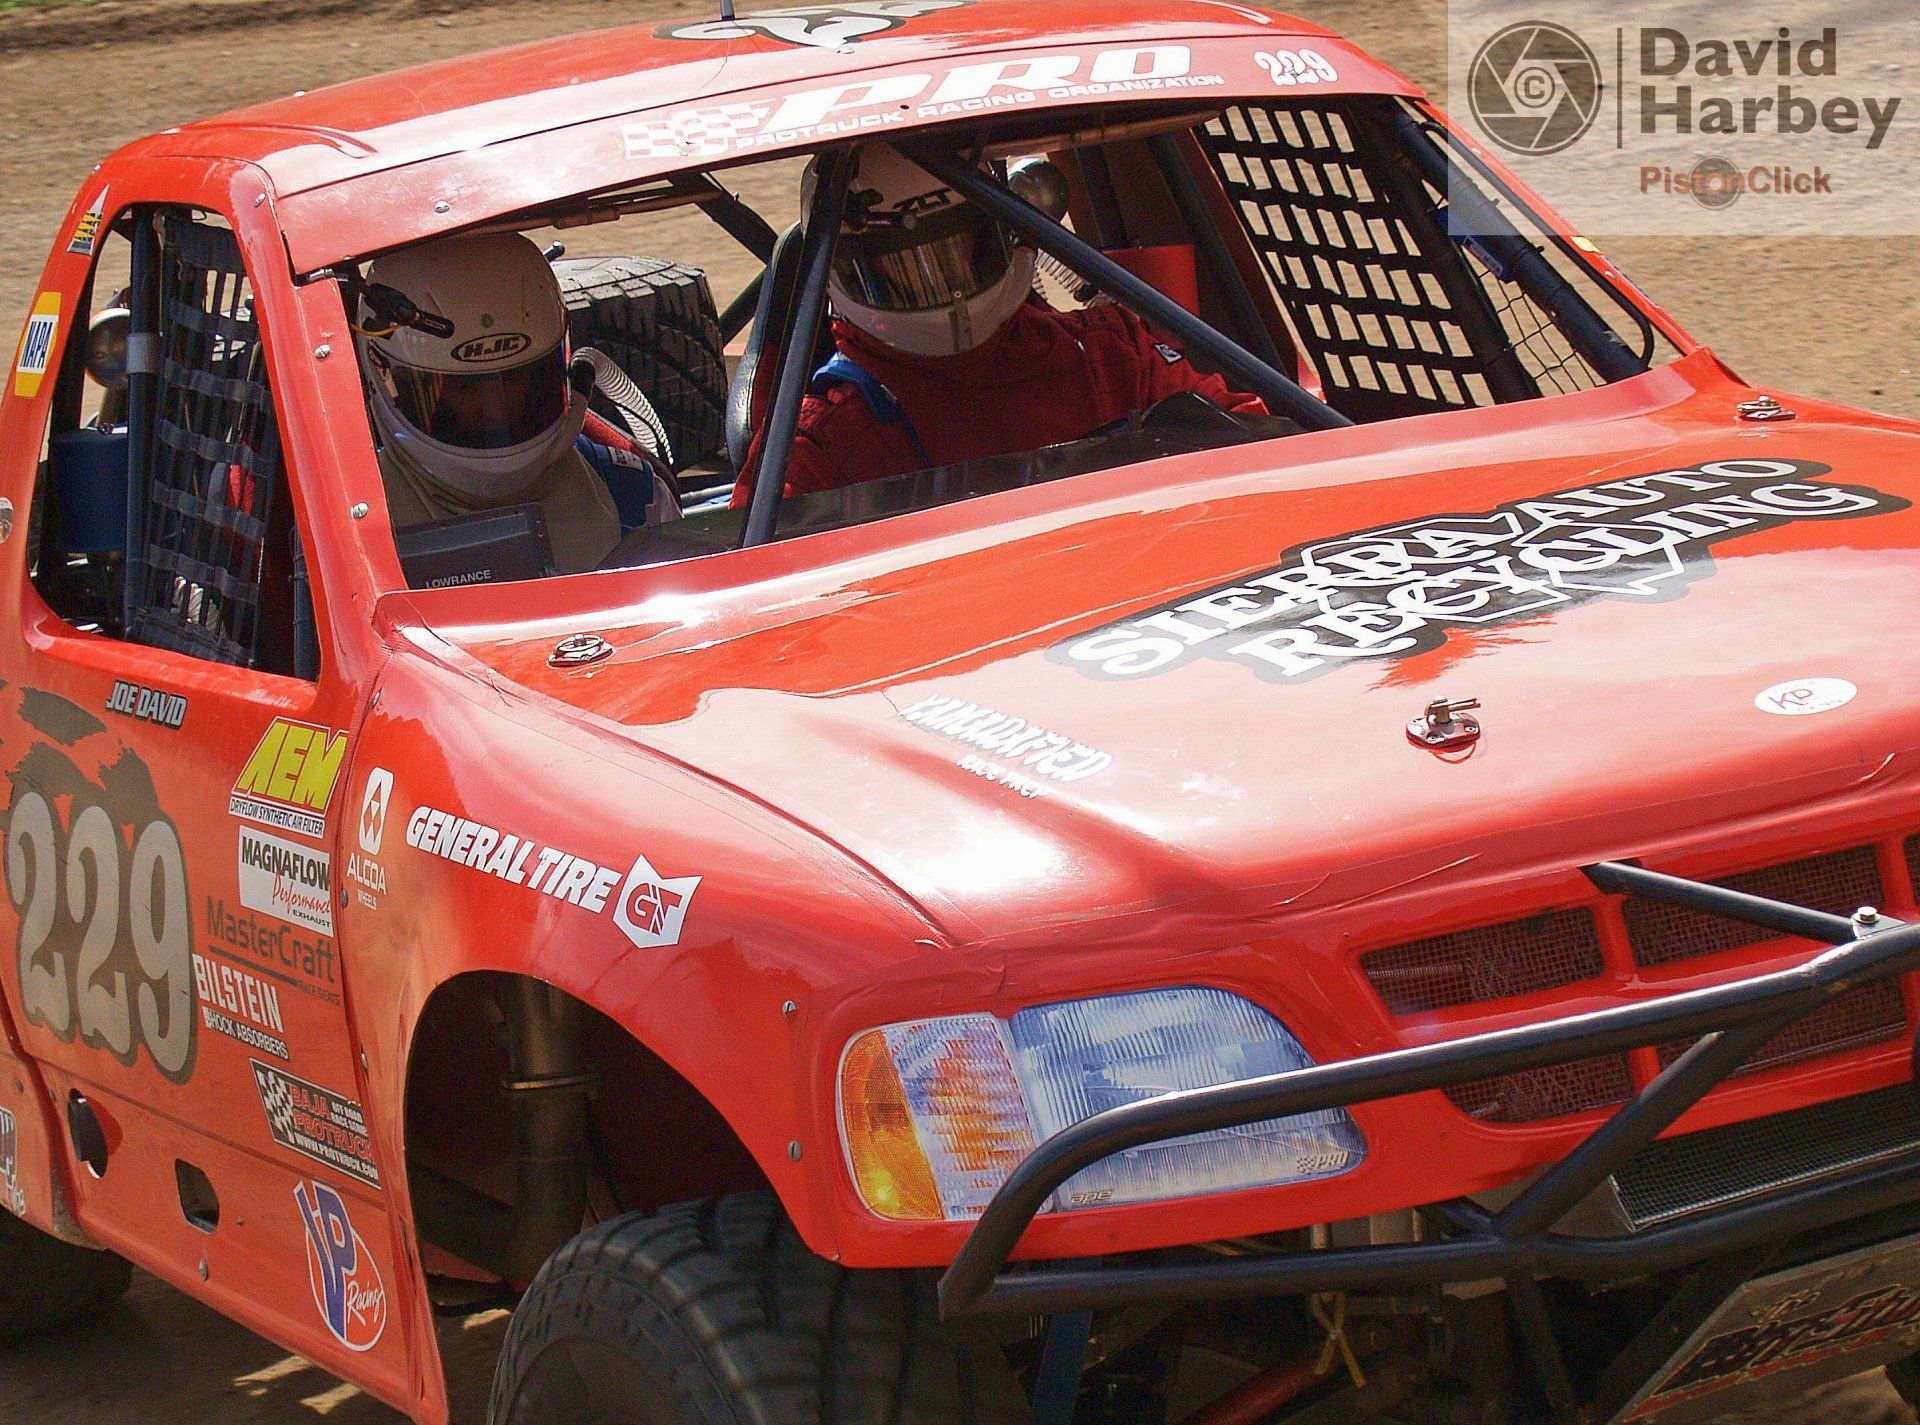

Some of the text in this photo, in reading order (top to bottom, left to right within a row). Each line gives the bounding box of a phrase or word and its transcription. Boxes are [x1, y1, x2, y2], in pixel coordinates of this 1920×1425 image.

[757, 46, 1191, 135] PRO
[1253, 49, 1338, 86] 229
[737, 74, 1225, 149] PROTRUCK RACING ORGANIZATION
[19, 320, 53, 369] NAPA
[464, 337, 520, 358] HJC
[425, 569, 492, 589] LOWRANCE
[1068, 459, 1797, 676] SIERRA AUTO
[1226, 483, 1879, 677] RECYCLING
[105, 680, 188, 728] JOE DAVID
[235, 721, 348, 810] AEM
[230, 798, 324, 835] DRYFLOW SYNTHETIC AIR FILTER
[242, 836, 330, 892] MAGNAFLOW
[346, 852, 387, 896] ALCOA
[406, 805, 623, 914] GENERAL TIRE
[7, 790, 192, 1073] 229
[207, 895, 335, 984] MasterCraft
[292, 909, 330, 928] EXHAUST
[192, 953, 284, 1034] BILSTEIN
[202, 1006, 289, 1060] SHOCK ABSORBERS
[289, 1084, 332, 1121] BAJA
[347, 1279, 383, 1328] Racing
